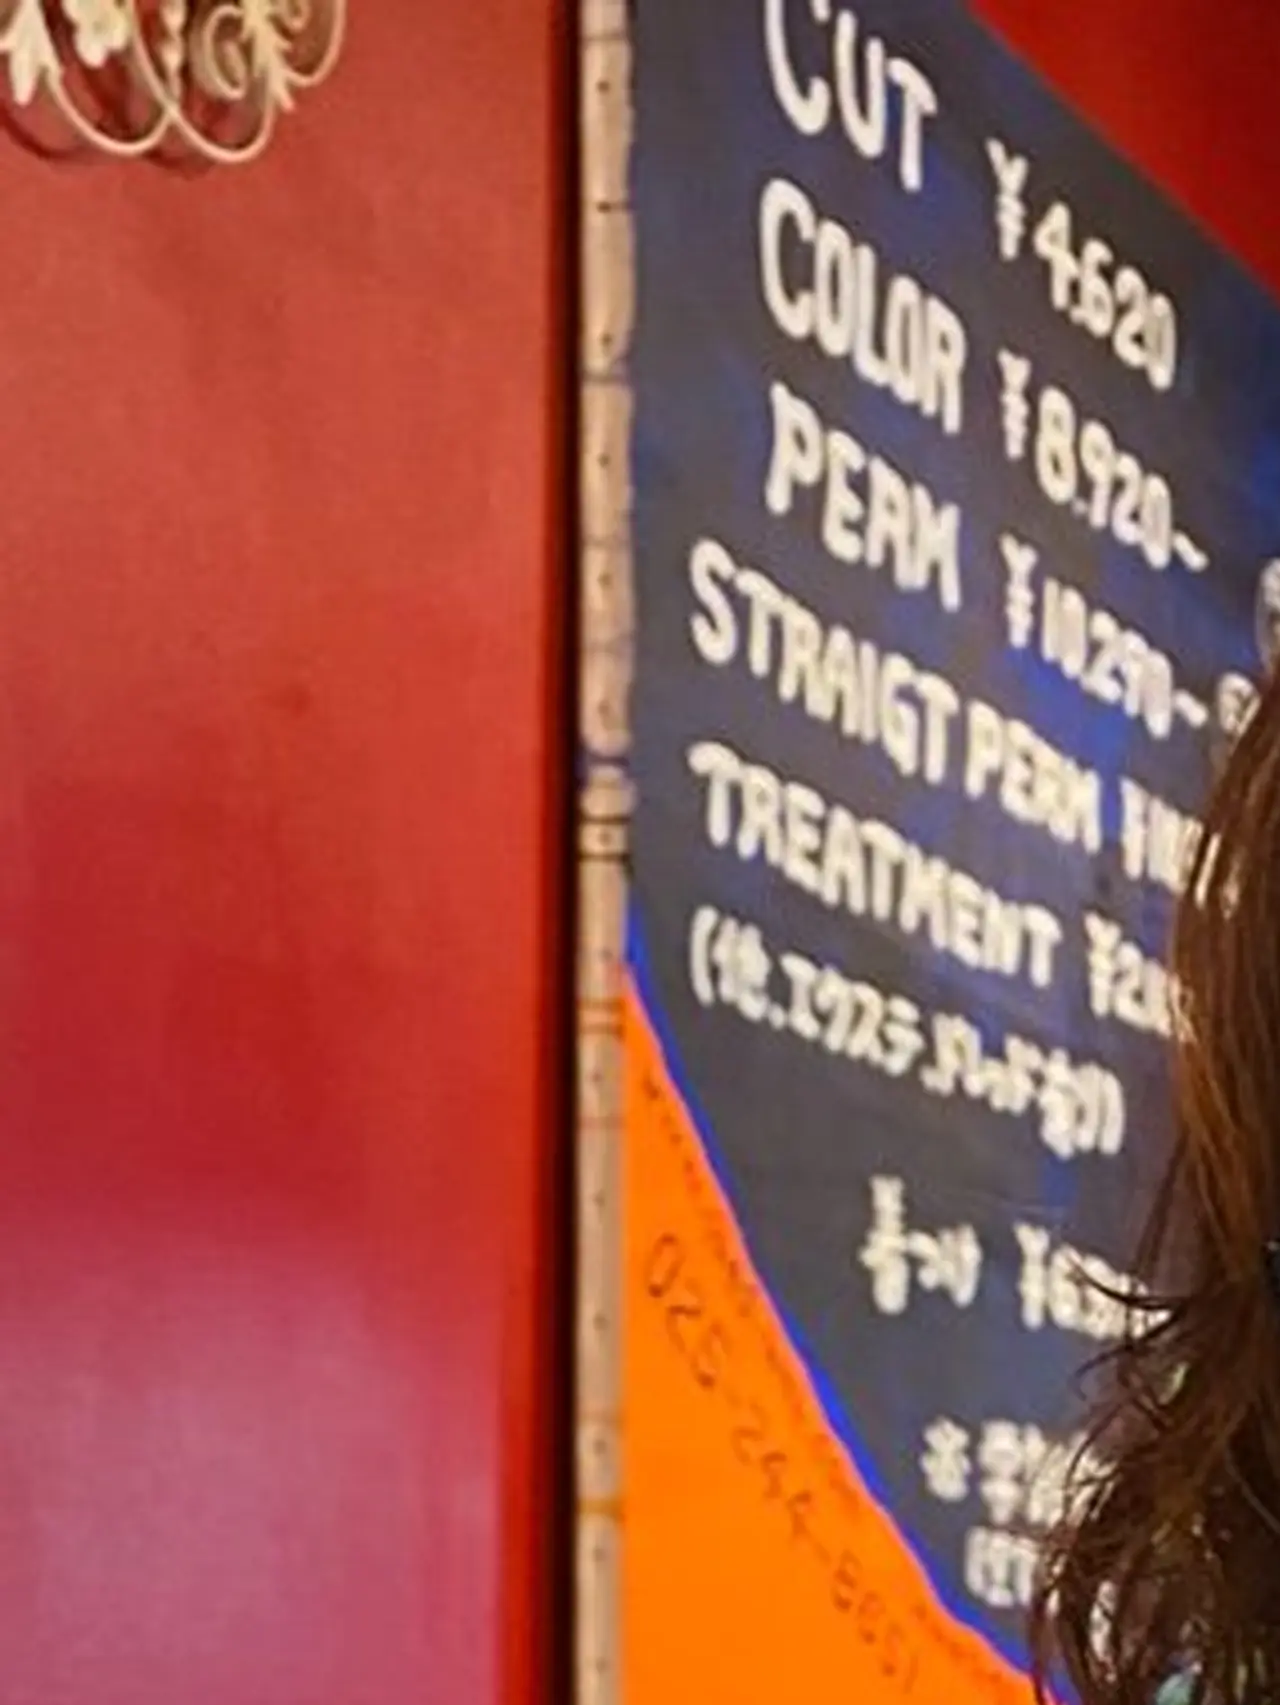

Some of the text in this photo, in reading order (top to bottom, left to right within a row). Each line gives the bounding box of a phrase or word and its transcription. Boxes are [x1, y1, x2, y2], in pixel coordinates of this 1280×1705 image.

[764, 0, 937, 191] CUT
[760, 178, 967, 435] COLOR
[764, 382, 961, 612] PERM
[687, 537, 960, 787] STRAIGT
[964, 697, 1103, 855] PERM
[687, 739, 1062, 990] TREATMENT
